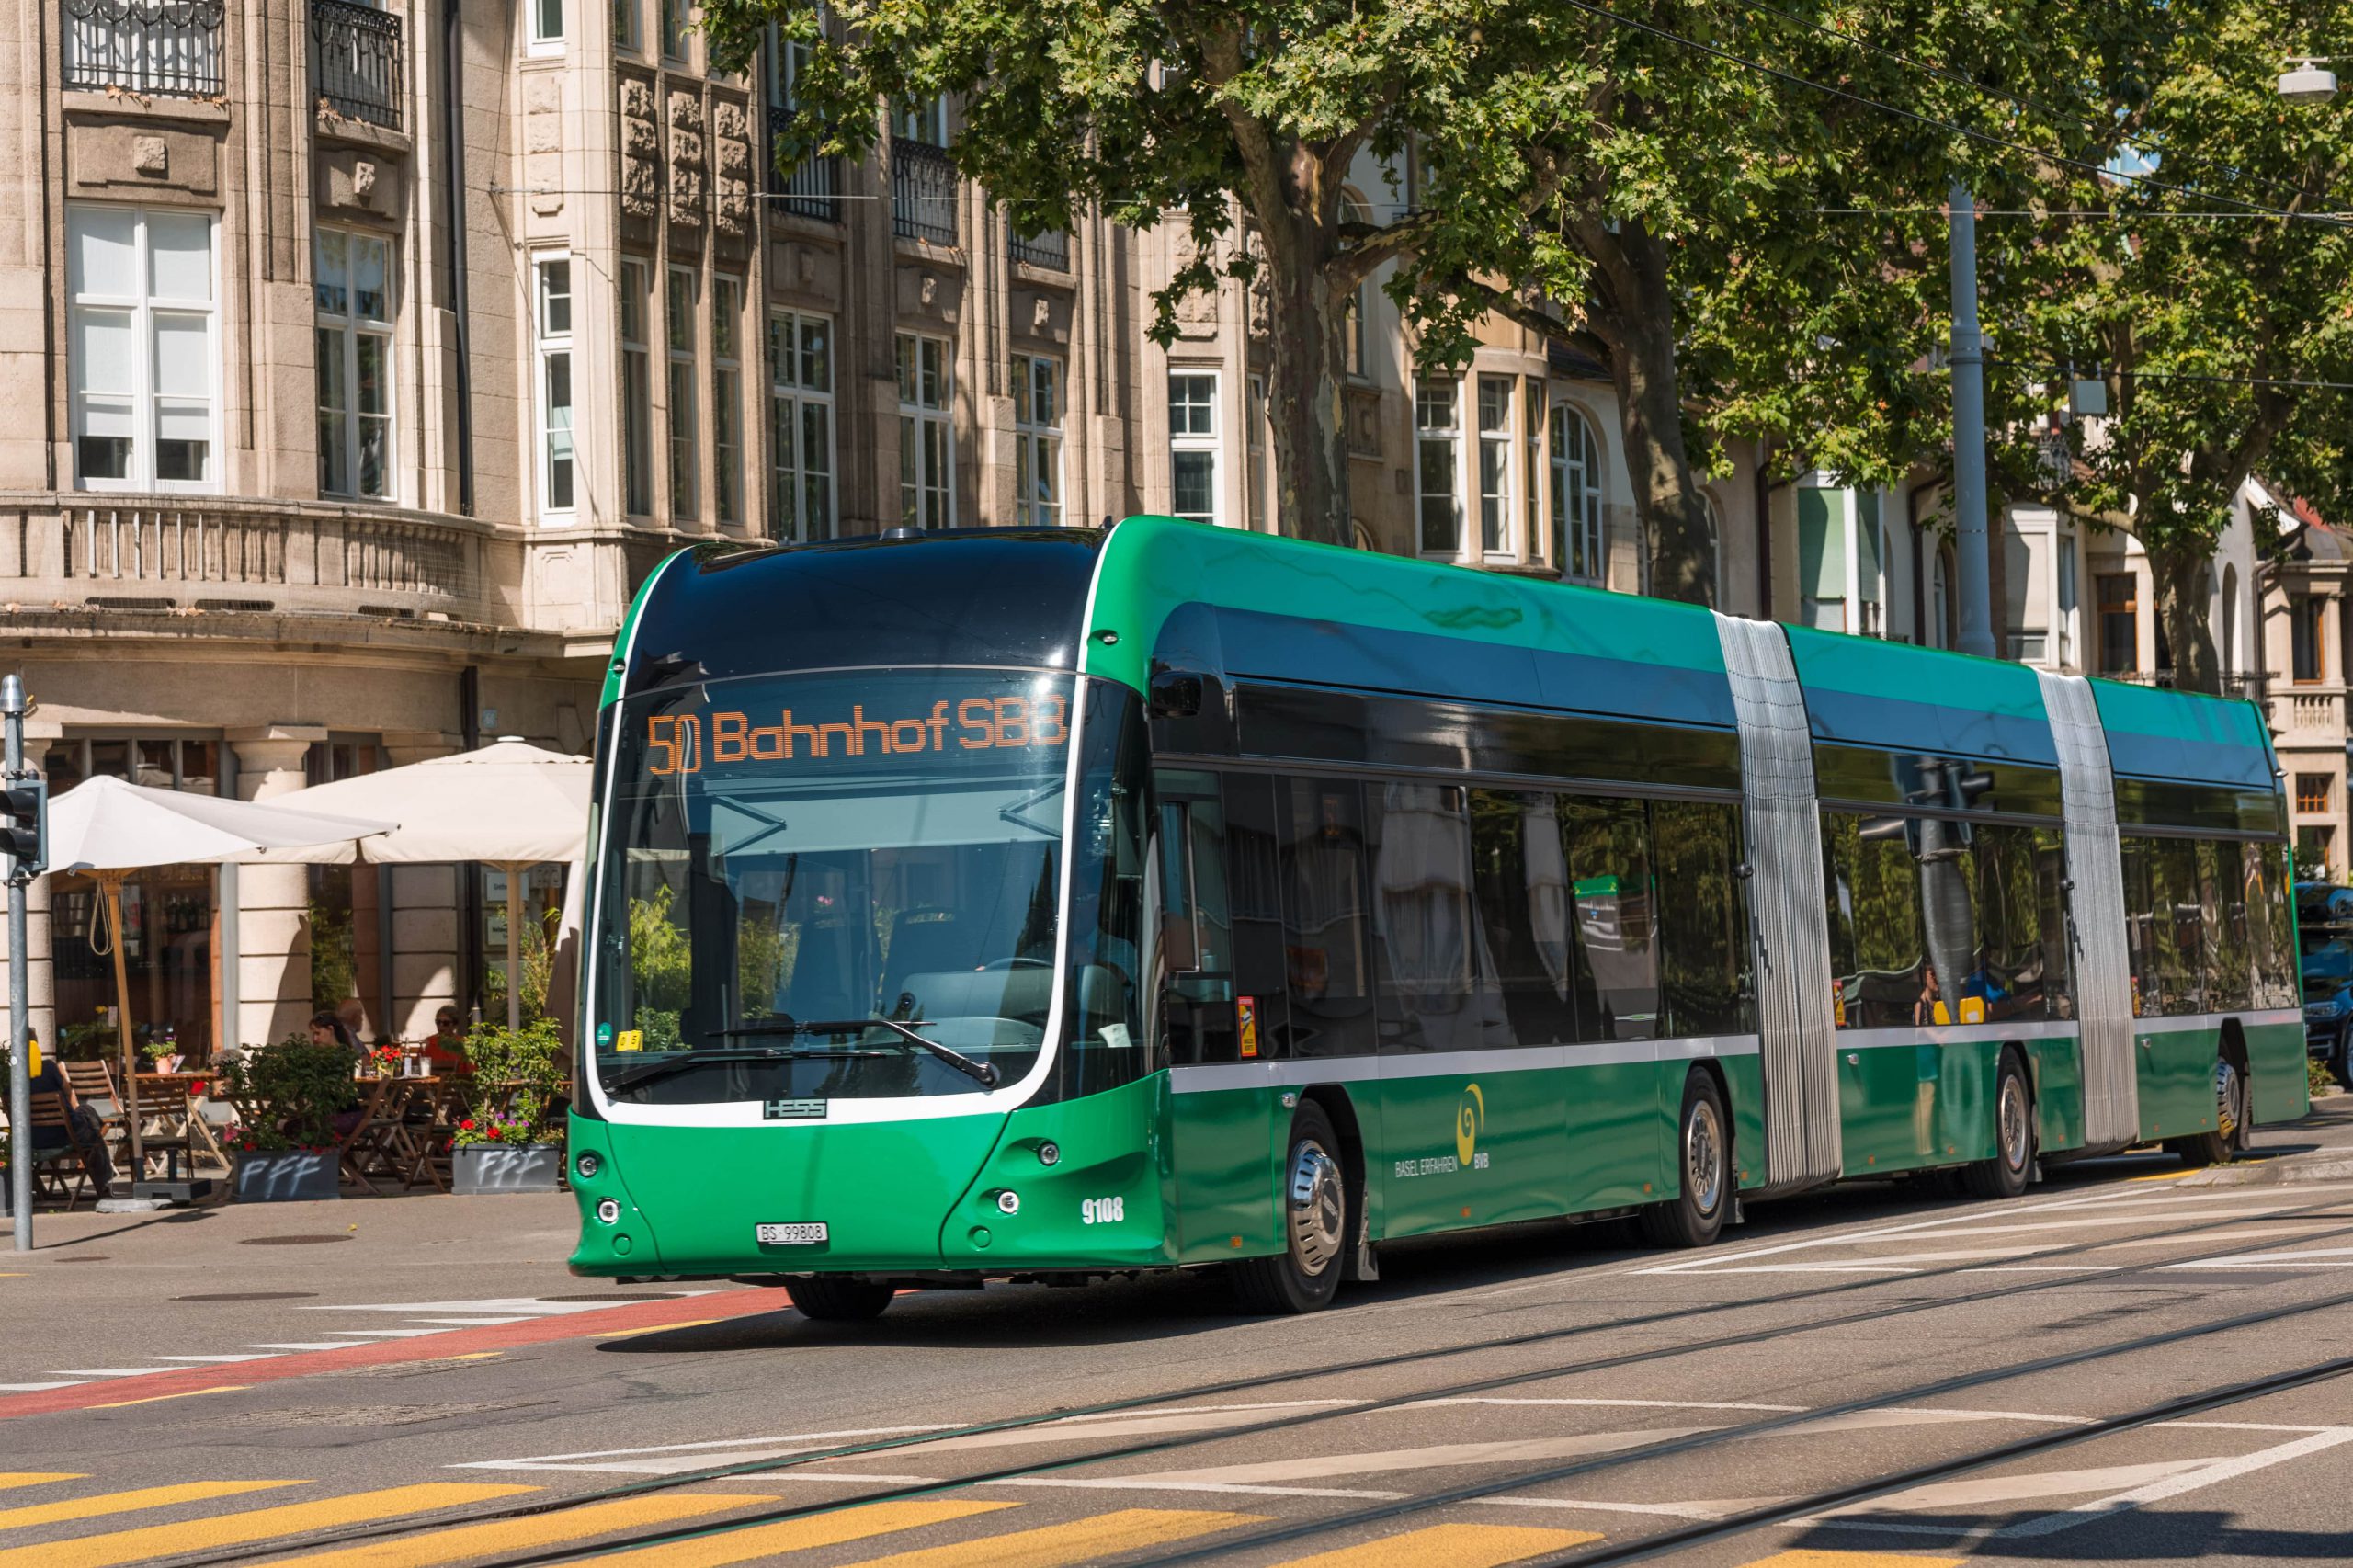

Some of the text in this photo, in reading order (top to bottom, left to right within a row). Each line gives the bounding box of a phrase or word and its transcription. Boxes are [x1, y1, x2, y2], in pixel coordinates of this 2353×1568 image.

[648, 695, 1068, 775] 50 Bahnhof SBB
[765, 1099, 826, 1118] HESS
[1395, 1156, 1458, 1177] BASEL ERFAHREN
[1474, 1153, 1489, 1169] BVB
[1082, 1196, 1124, 1224] 9108
